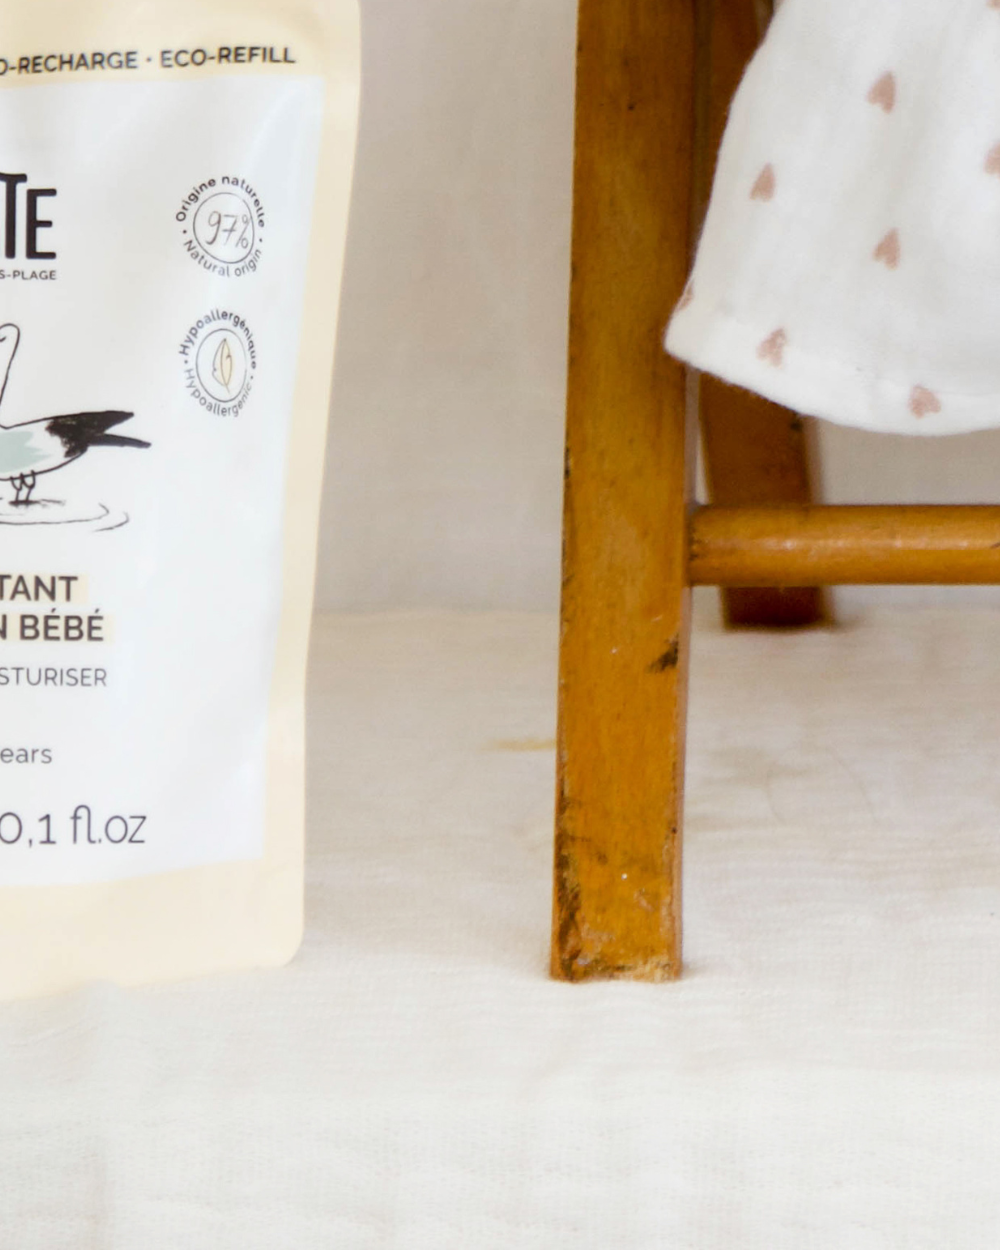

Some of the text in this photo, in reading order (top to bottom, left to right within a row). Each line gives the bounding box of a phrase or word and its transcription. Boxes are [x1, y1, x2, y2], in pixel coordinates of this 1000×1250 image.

[159, 45, 297, 69] ECO-REFILL
[175, 175, 265, 228] Origine naturelle
[183, 239, 262, 278] Natural origin
[178, 308, 257, 370] Hypoallergénique
[184, 368, 252, 418] Hypoallergenic
[19, 608, 105, 642] BÉBÉ
[69, 804, 148, 844] fl.oz
